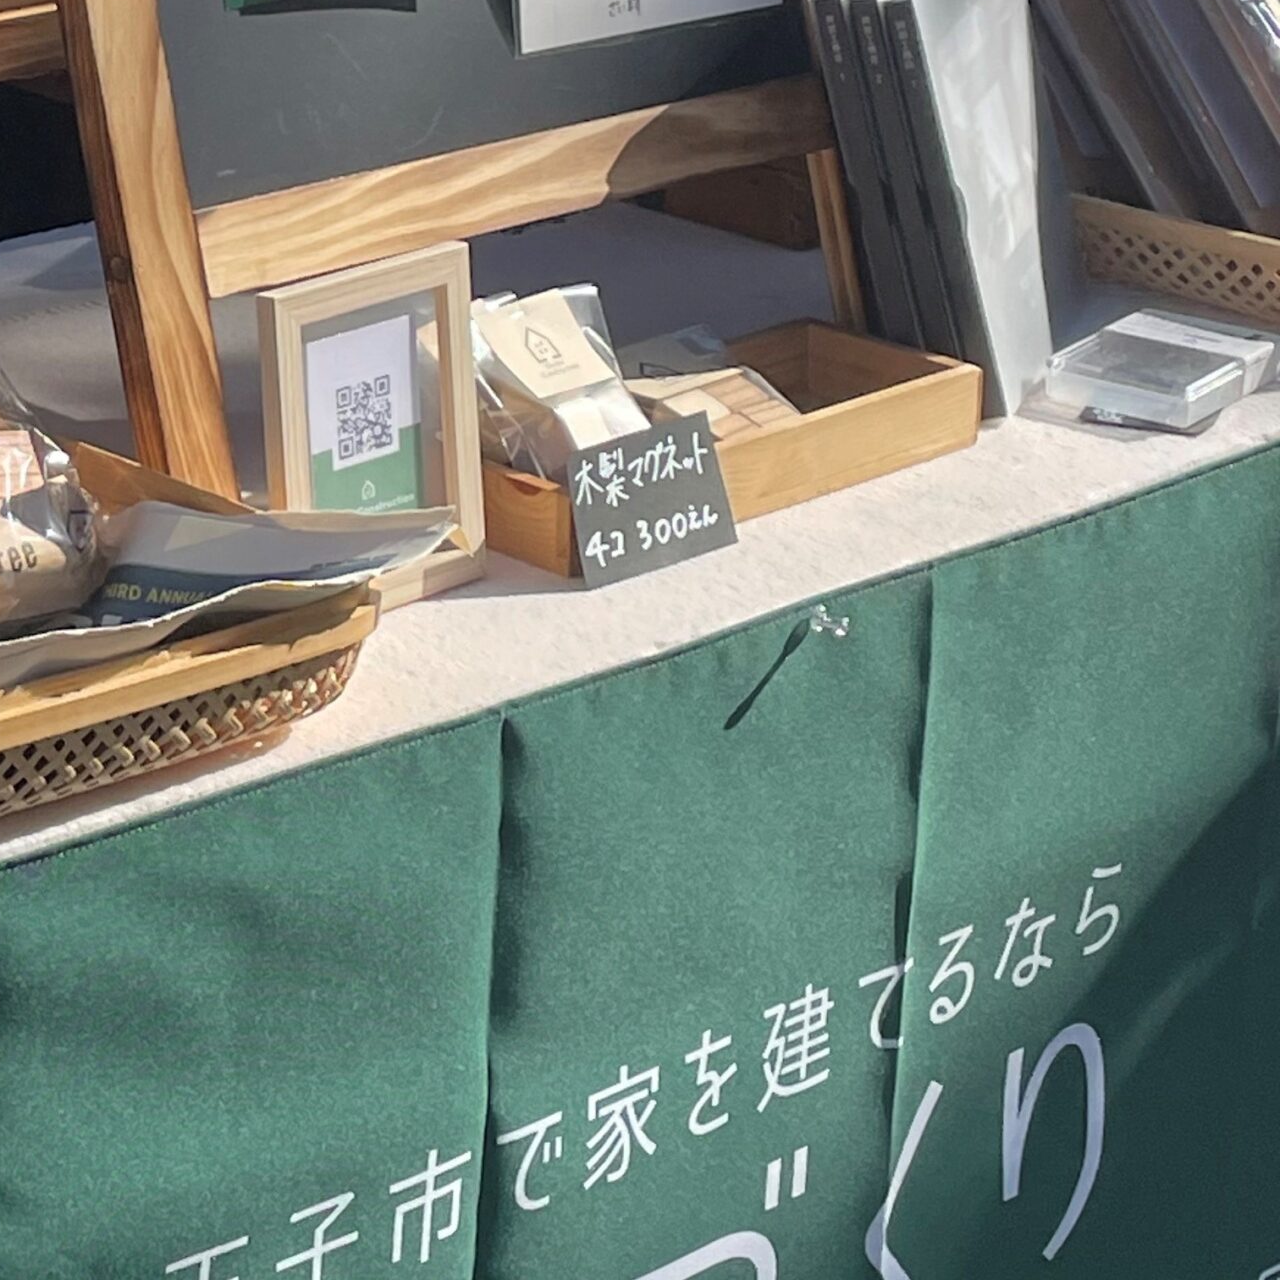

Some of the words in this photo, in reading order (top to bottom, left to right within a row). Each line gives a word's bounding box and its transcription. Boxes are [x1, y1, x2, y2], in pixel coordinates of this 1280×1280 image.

[574, 431, 709, 508] 木製マグネット
[636, 504, 719, 551] 300えん
